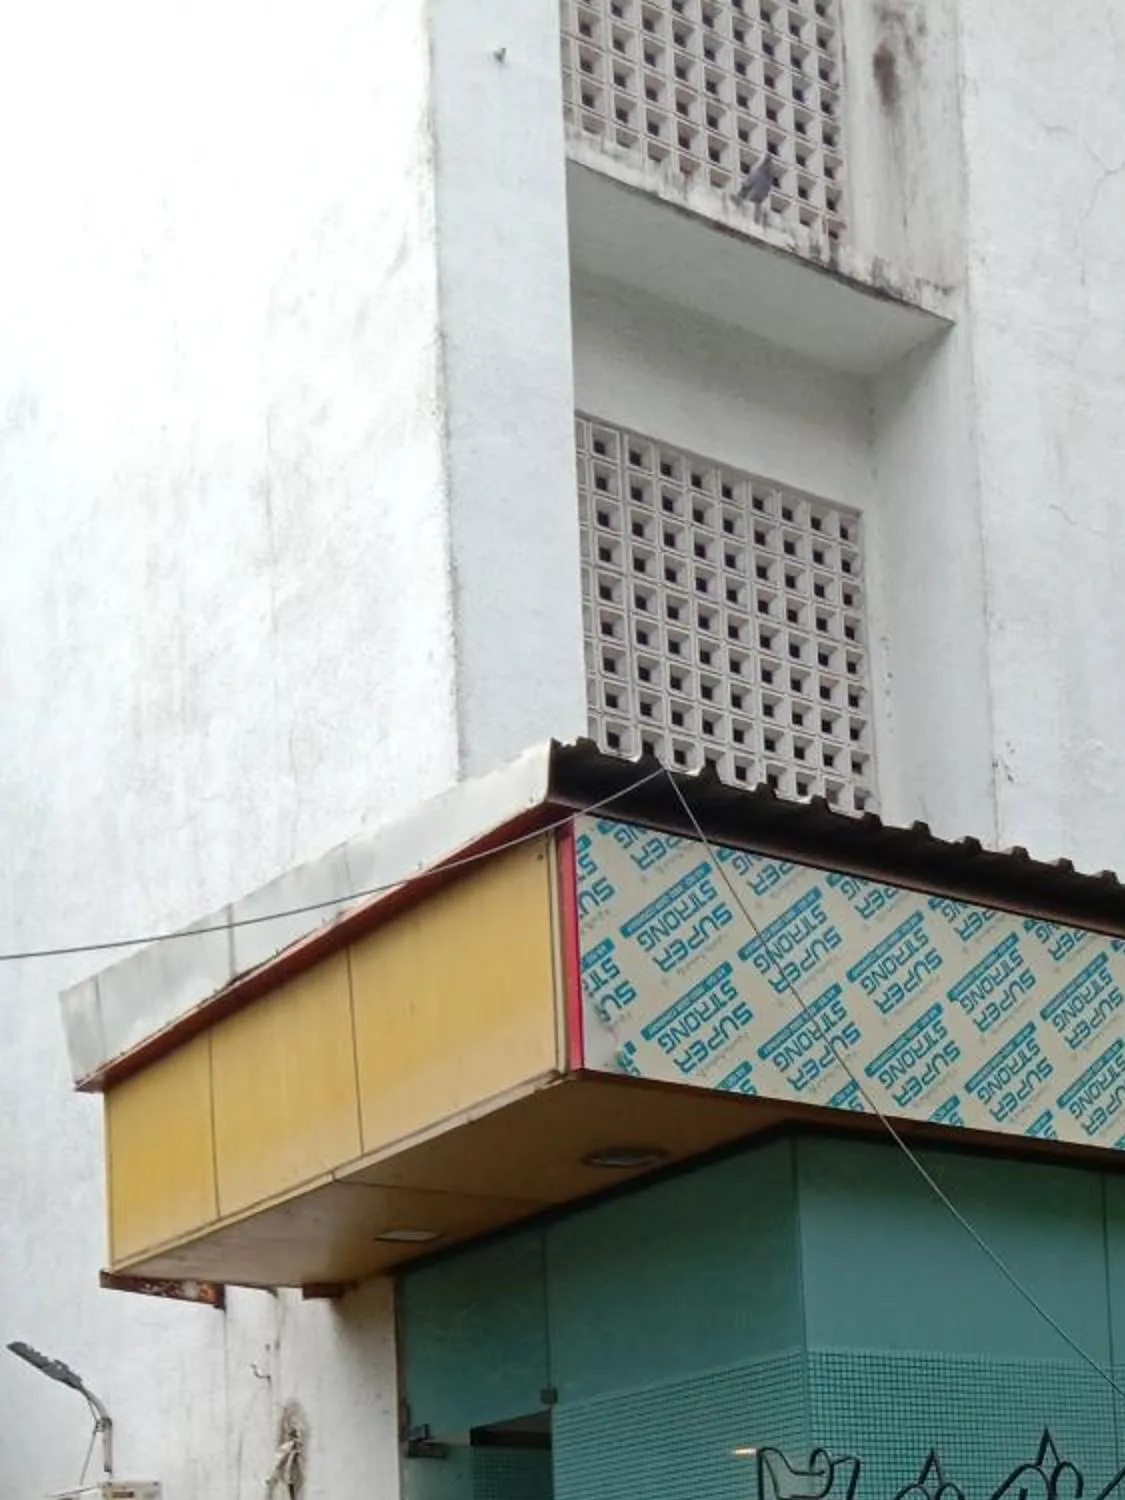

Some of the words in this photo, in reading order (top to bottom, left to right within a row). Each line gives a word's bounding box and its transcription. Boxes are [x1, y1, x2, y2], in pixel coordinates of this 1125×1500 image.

[636, 880, 718, 951] STRONG
[653, 902, 733, 973] SUPER
[753, 904, 827, 974] STRONG
[768, 926, 842, 993] SUPER
[860, 927, 929, 995] STRONG
[874, 948, 943, 1014] SUPER
[959, 948, 1024, 1014] STRONG
[657, 980, 738, 1054] STRONG
[972, 968, 1036, 1032] SUPER
[1052, 967, 1113, 1032] STRONG
[1064, 987, 1124, 1049] SUPER
[673, 1002, 753, 1073] SUPER
[773, 1000, 847, 1072] STRONG
[787, 1021, 861, 1091] SUPER
[878, 1020, 947, 1090] STRONG
[893, 1040, 960, 1107] SUPER
[977, 1038, 1041, 1104] STRONG
[990, 1057, 1053, 1122] SUPER
